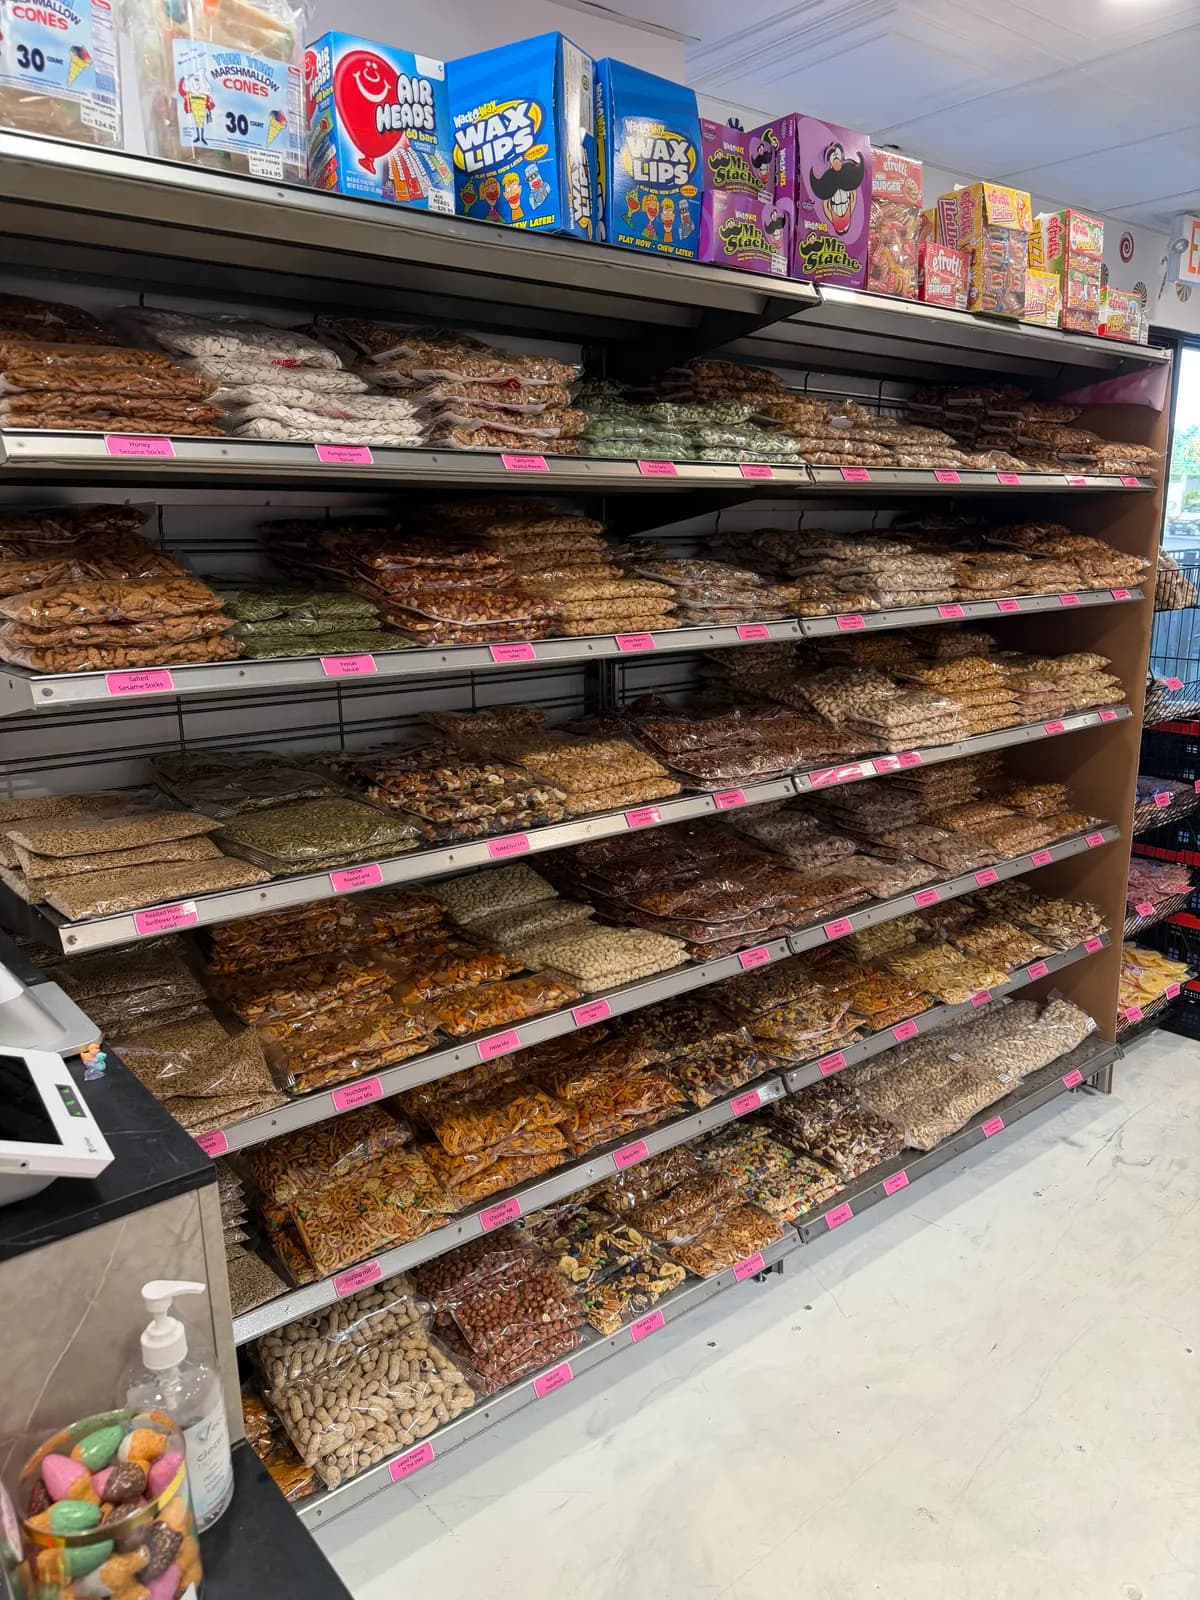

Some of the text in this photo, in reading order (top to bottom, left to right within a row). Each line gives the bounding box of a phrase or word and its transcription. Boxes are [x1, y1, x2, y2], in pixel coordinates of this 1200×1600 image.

[12, 5, 69, 31] CONES
[17, 44, 45, 73] 30
[212, 52, 242, 66] YUM
[246, 55, 275, 80] YUM
[210, 66, 280, 92] MARSHMALLOW
[222, 78, 269, 97] CONES
[397, 74, 433, 106] AIR
[225, 112, 249, 136] 30
[376, 103, 435, 133] HEADS
[454, 102, 532, 151] WAX
[406, 128, 438, 145] 60 bars
[627, 136, 690, 163] WAX
[464, 127, 534, 173] LIPS
[632, 158, 690, 186] LIPS
[714, 166, 764, 189] Stache
[883, 158, 907, 177] efrutti
[872, 180, 901, 192] BURGER
[529, 214, 555, 227] LATER!
[617, 234, 633, 247] PLAY
[635, 238, 651, 249] NOW
[657, 243, 673, 254] CHEW
[675, 248, 694, 258] LATER!
[725, 235, 777, 255] Stache
[1047, 216, 1063, 260] efrutti
[803, 250, 861, 273] Stache
[932, 249, 962, 278] efrutti
[129, 441, 151, 449] Honey
